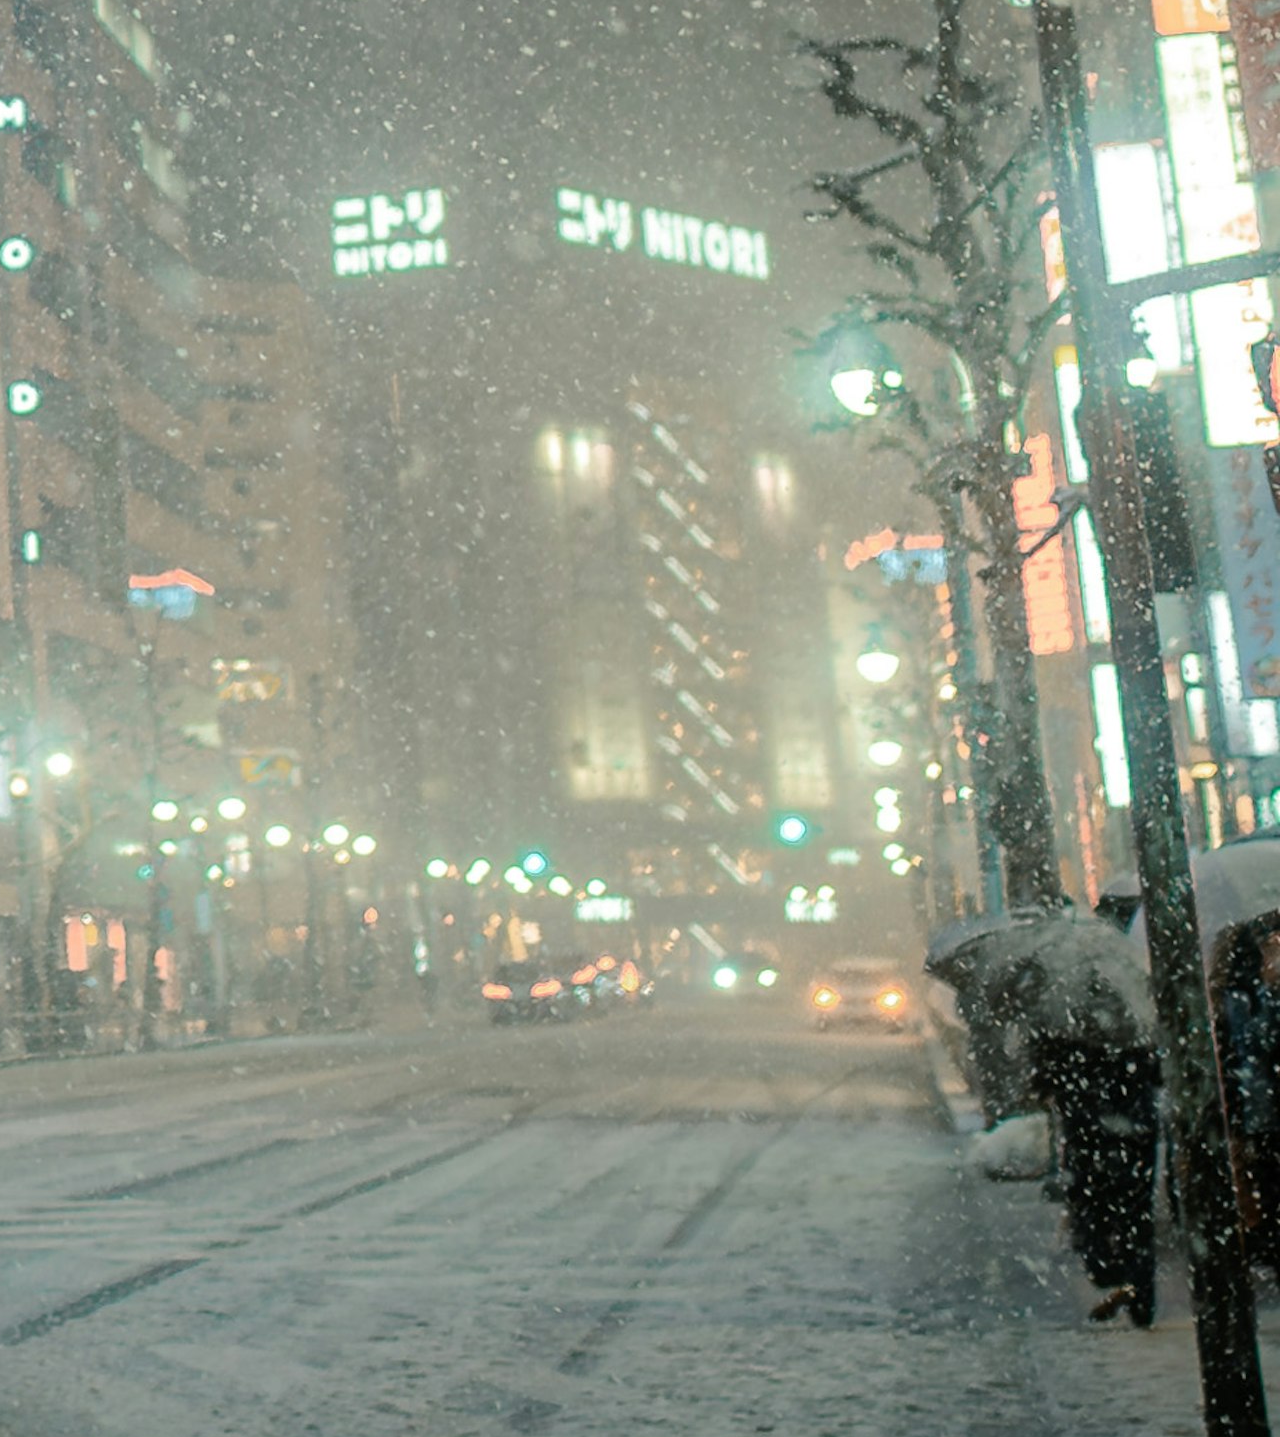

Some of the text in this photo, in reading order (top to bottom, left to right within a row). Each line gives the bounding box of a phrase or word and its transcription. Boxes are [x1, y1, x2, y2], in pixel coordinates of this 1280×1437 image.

[333, 188, 446, 245] ニトリ
[557, 187, 770, 282] ニトリ NITORI
[333, 238, 448, 276] NITORI
